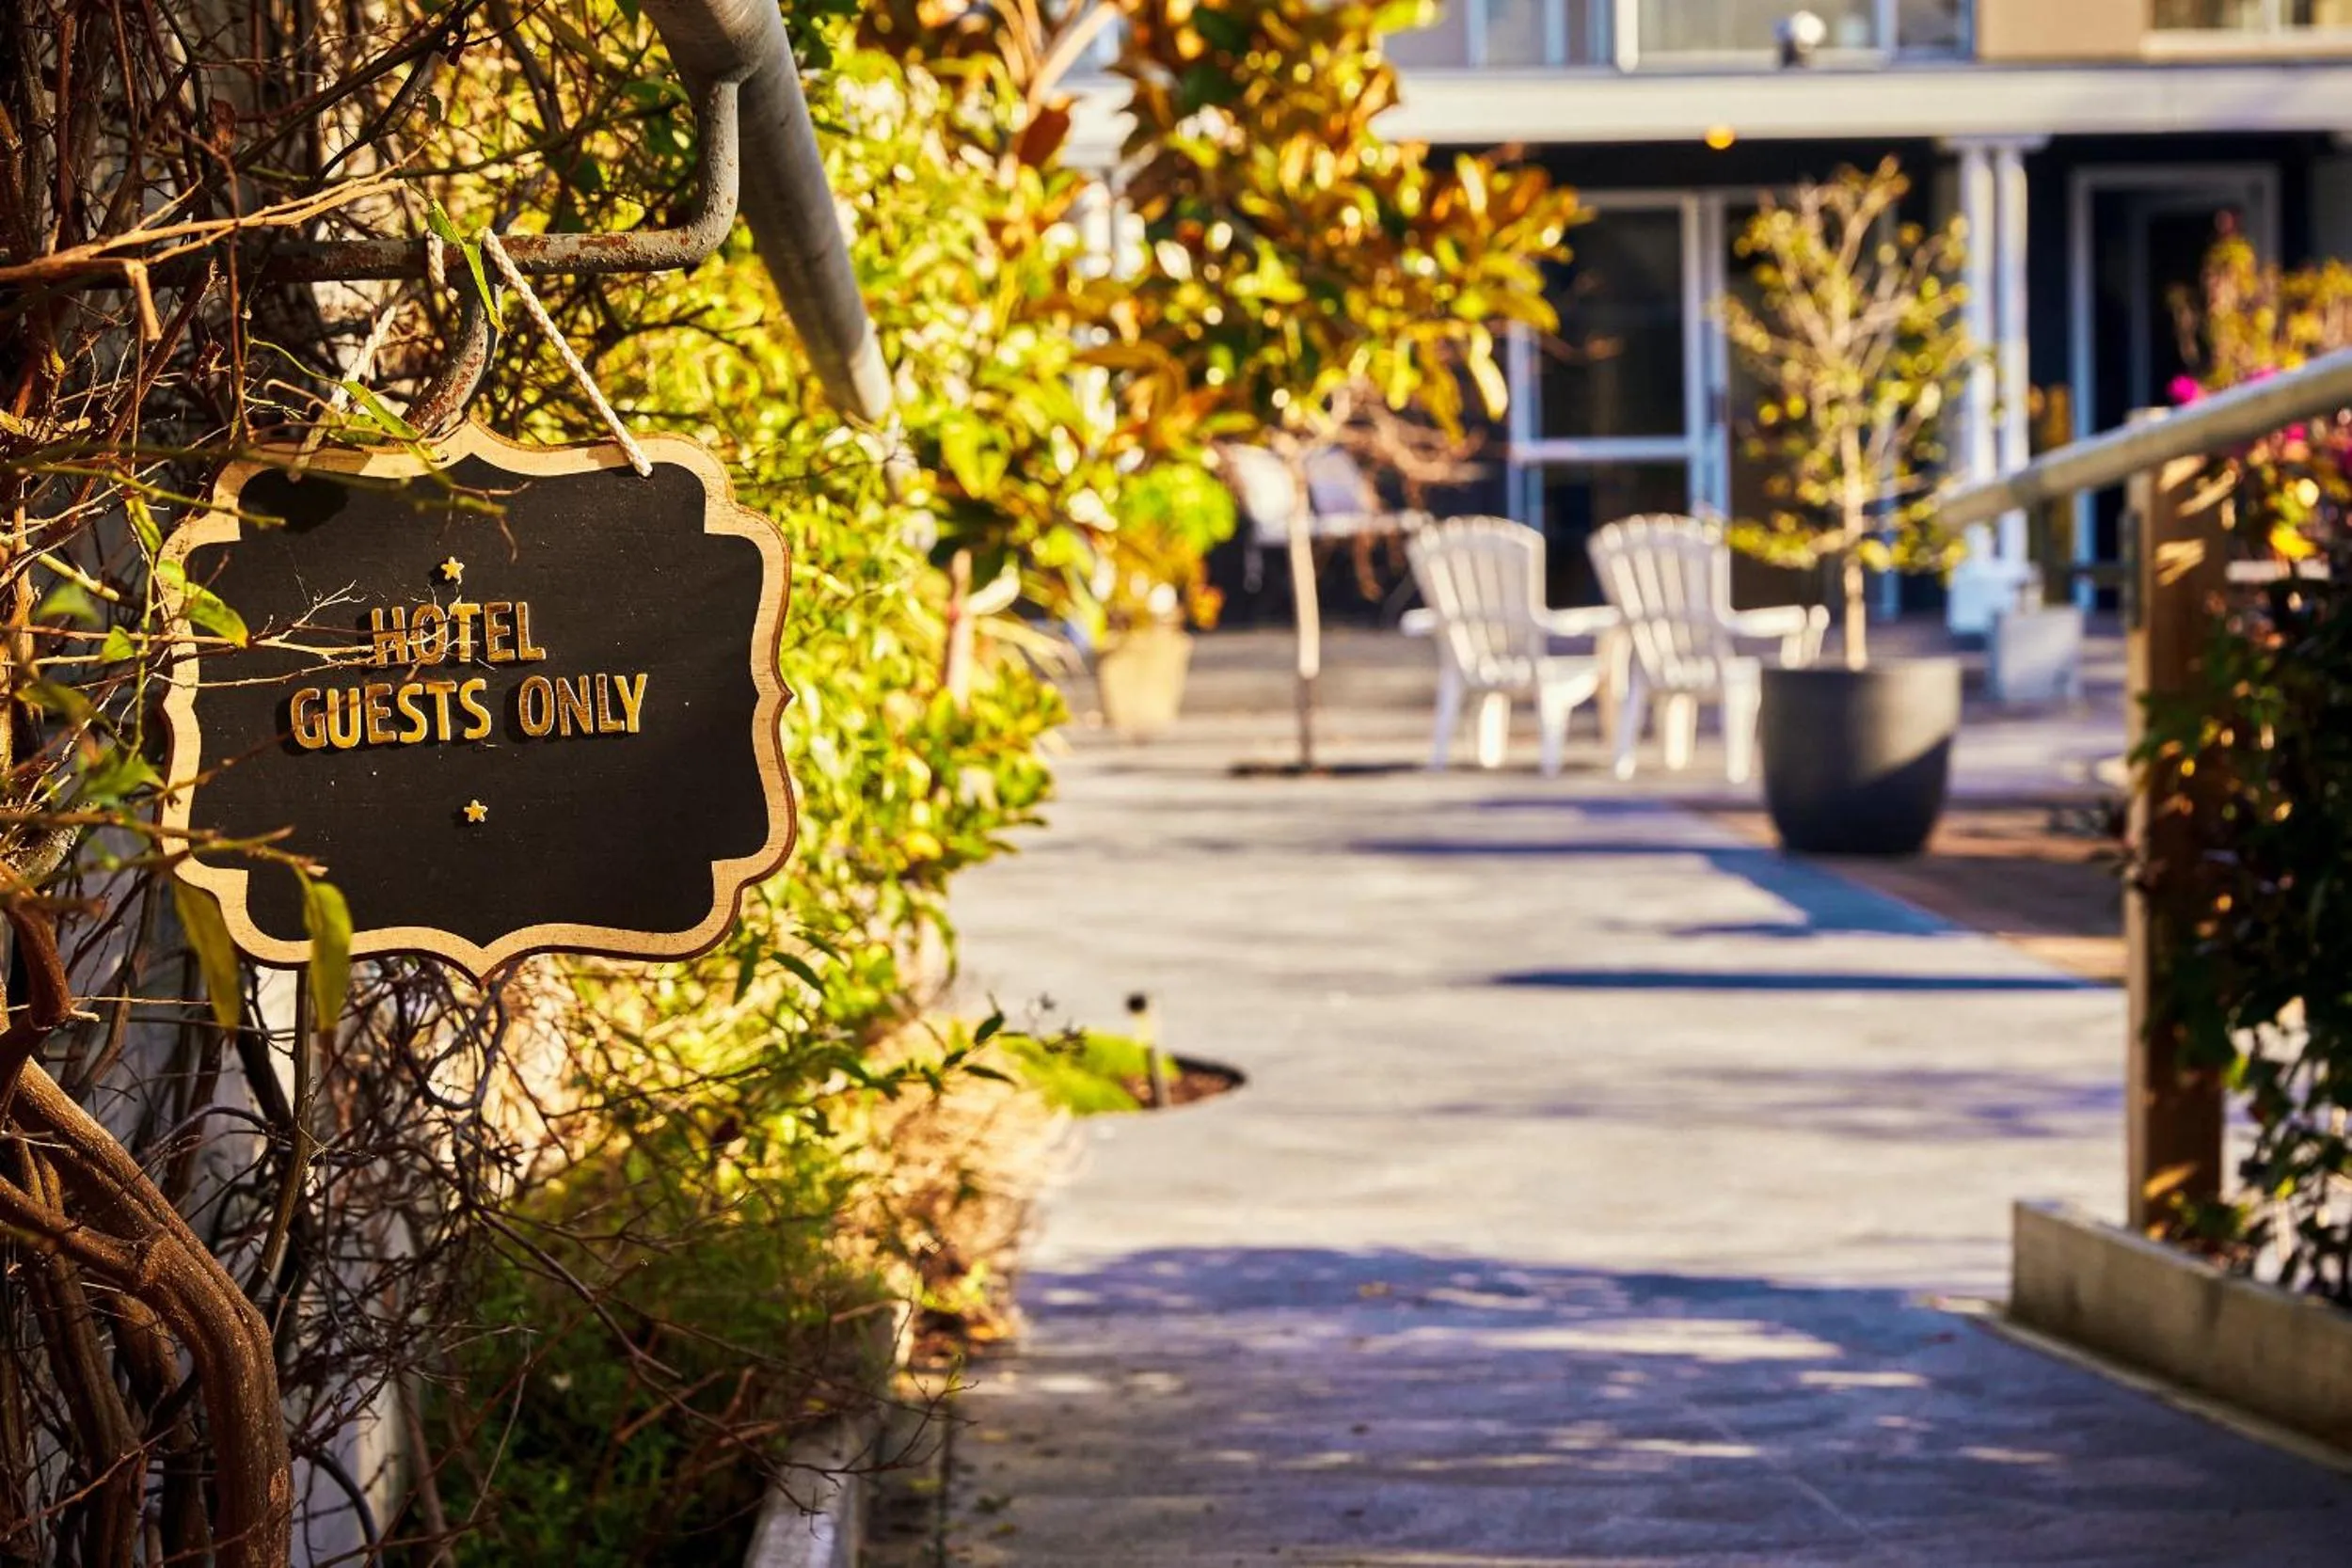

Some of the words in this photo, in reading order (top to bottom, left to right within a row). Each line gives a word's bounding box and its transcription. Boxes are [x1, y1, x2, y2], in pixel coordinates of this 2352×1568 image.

[371, 601, 547, 669] HOTEL
[290, 677, 492, 750] GUESTS
[518, 673, 649, 737] ONLY
